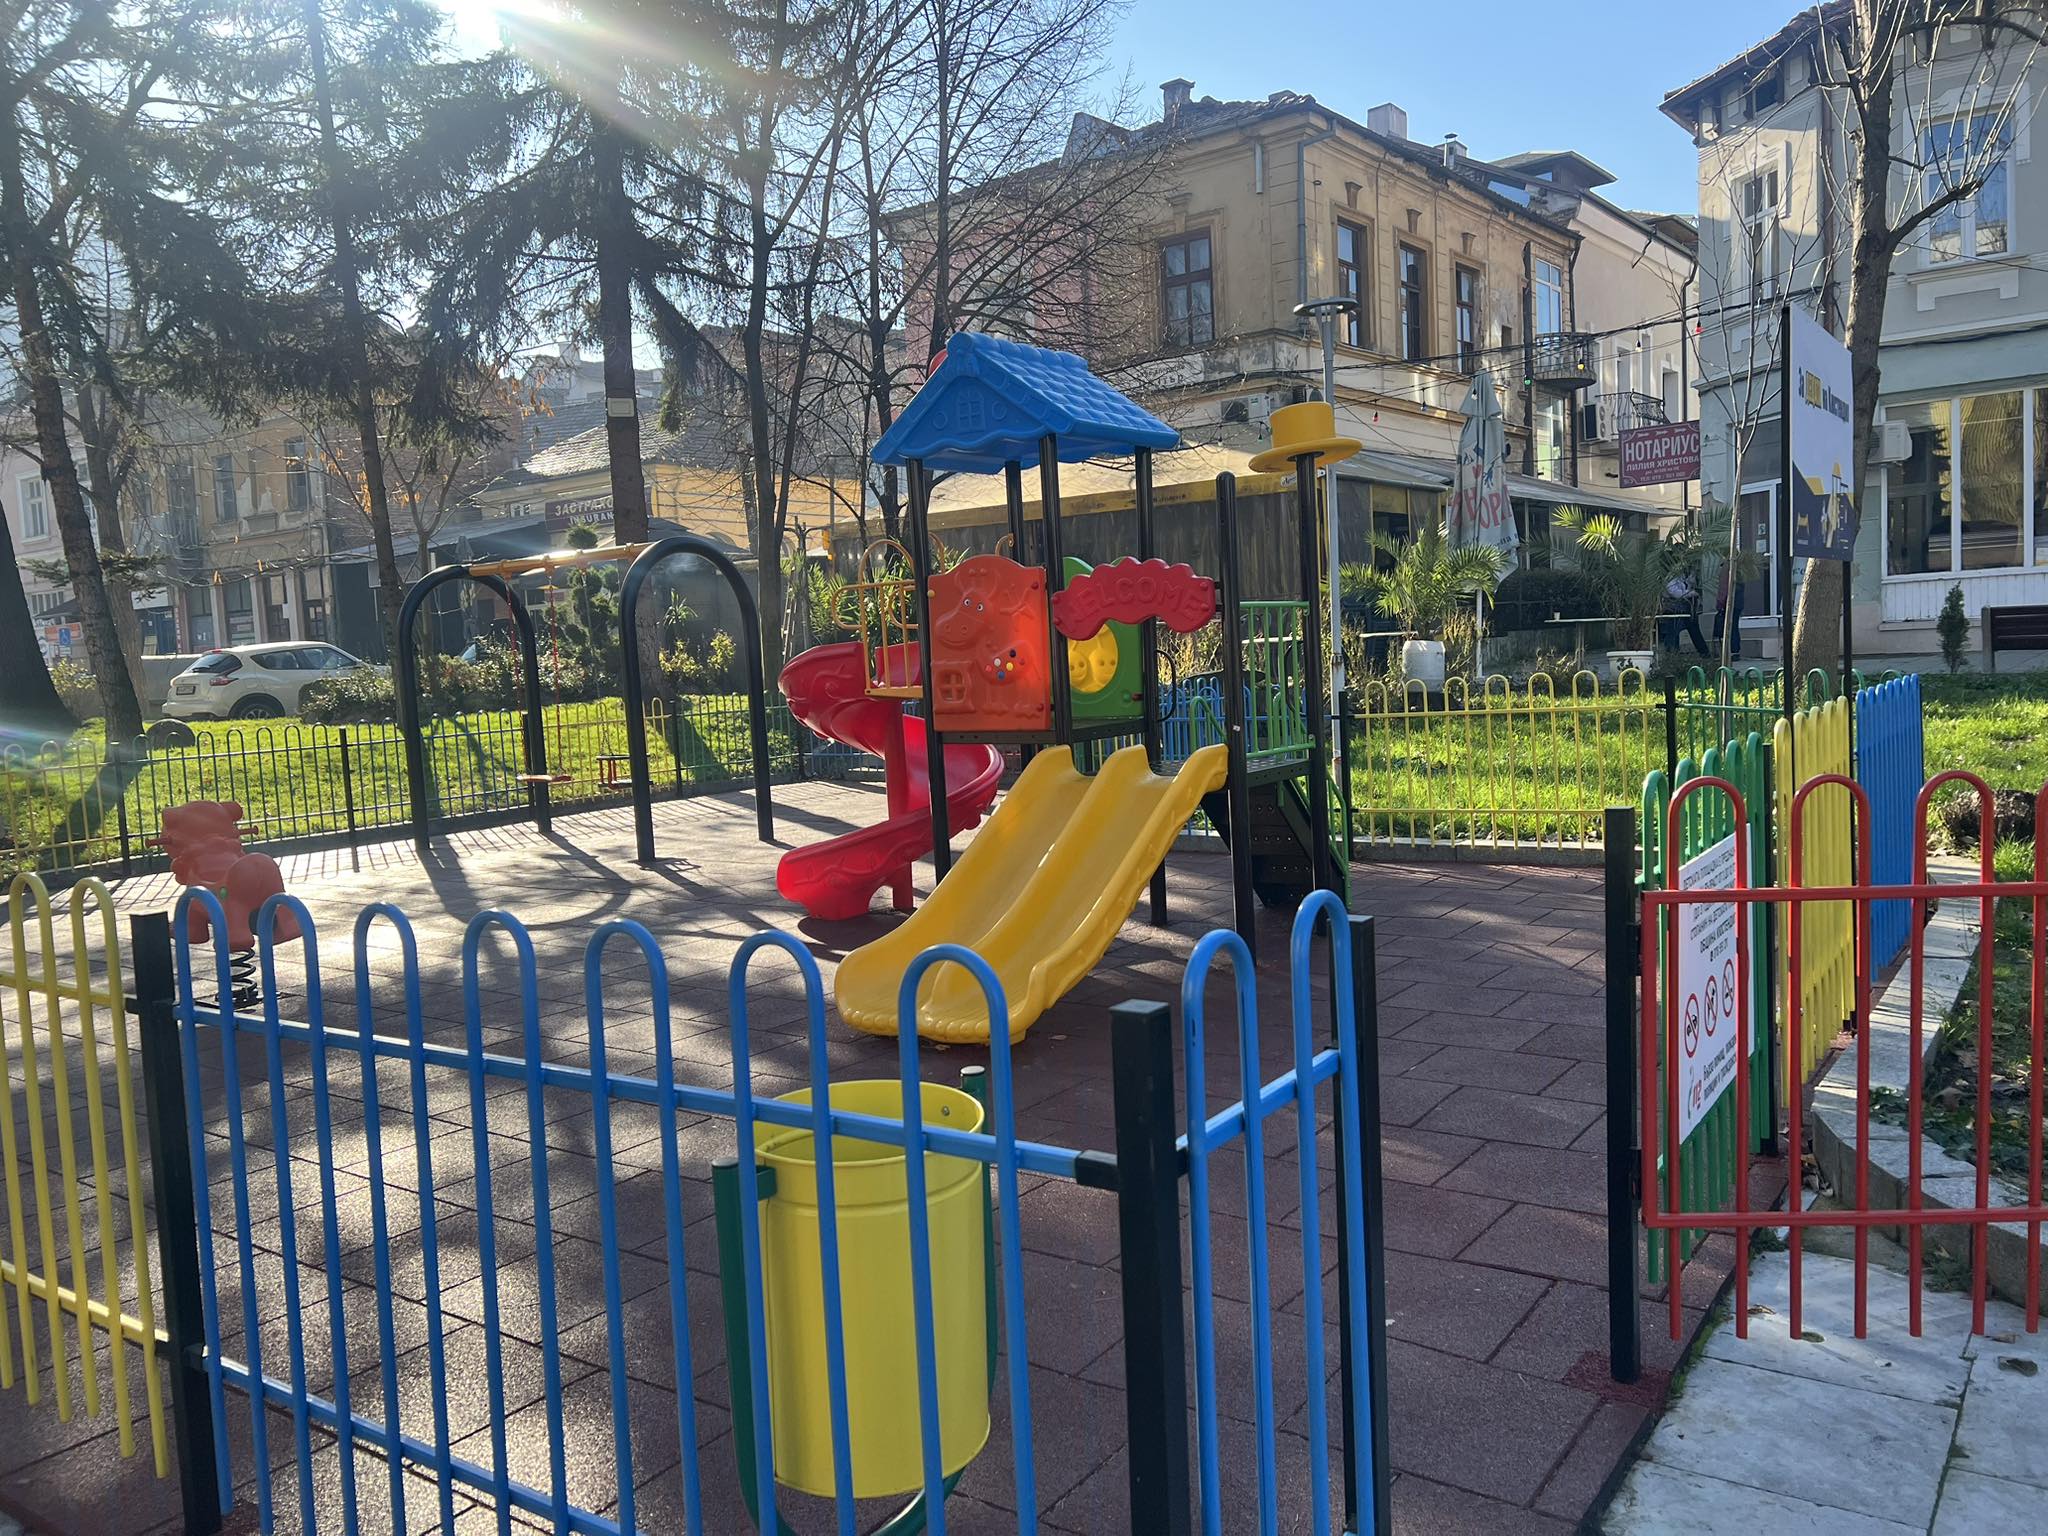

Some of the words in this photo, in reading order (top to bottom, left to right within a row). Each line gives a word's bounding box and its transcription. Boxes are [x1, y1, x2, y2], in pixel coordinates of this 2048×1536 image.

[1625, 433, 1700, 462] НОТАРИУС
[1626, 461, 1655, 472] ЛИЛИЯ
[1656, 455, 1699, 468] ХРИСТОВА
[555, 498, 614, 516] ЗАСТРАХО
[569, 511, 615, 525] INSURAN
[1067, 576, 1207, 627] WELCOME
